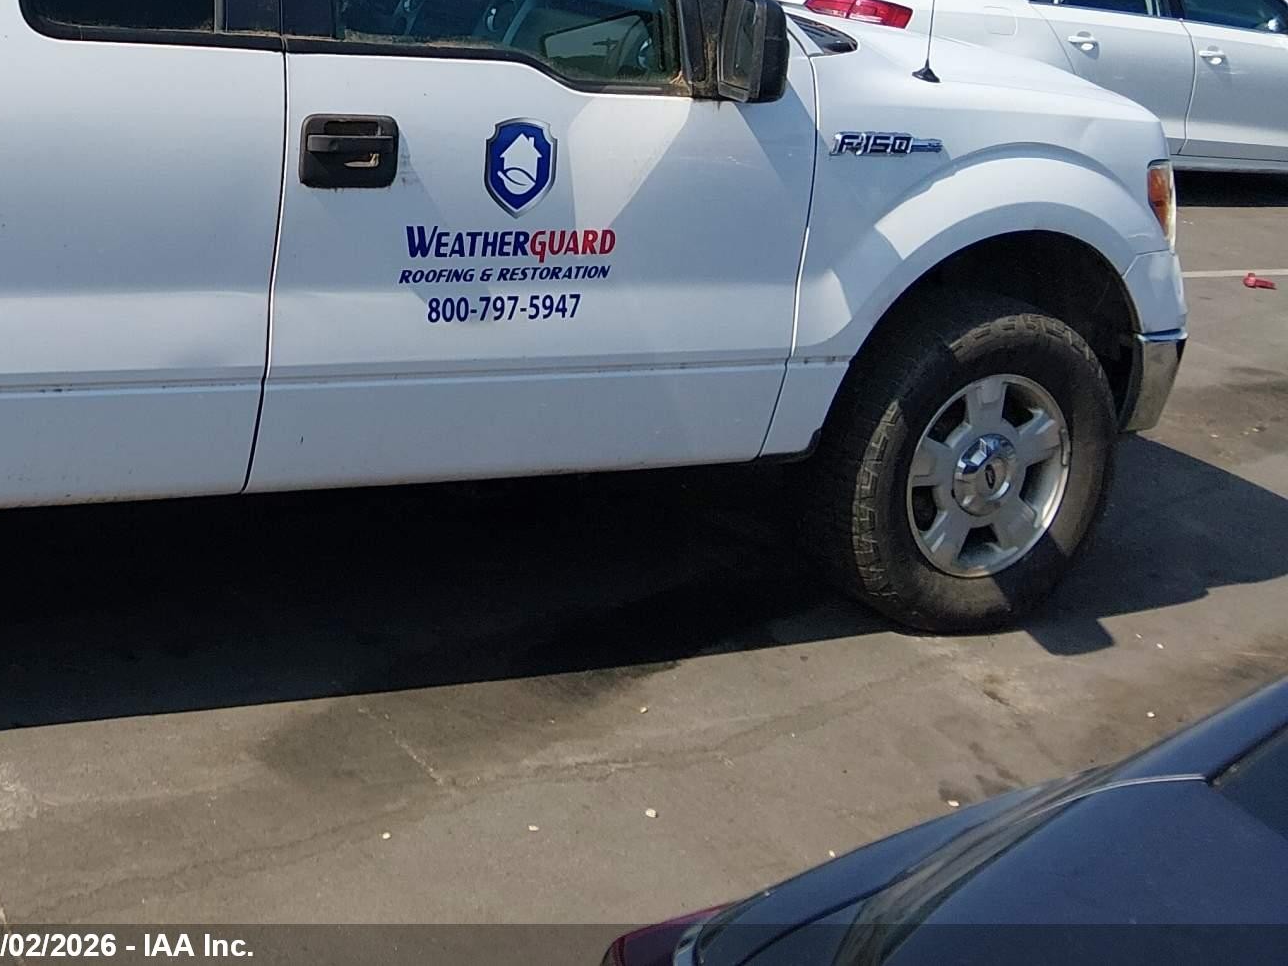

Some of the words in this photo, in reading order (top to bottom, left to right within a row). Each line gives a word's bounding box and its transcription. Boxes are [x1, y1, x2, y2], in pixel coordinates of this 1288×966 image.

[398, 268, 475, 284] ROOFING
[479, 267, 493, 282] &
[497, 265, 611, 281] RESTORATION
[427, 293, 581, 323] 800-797-5947
